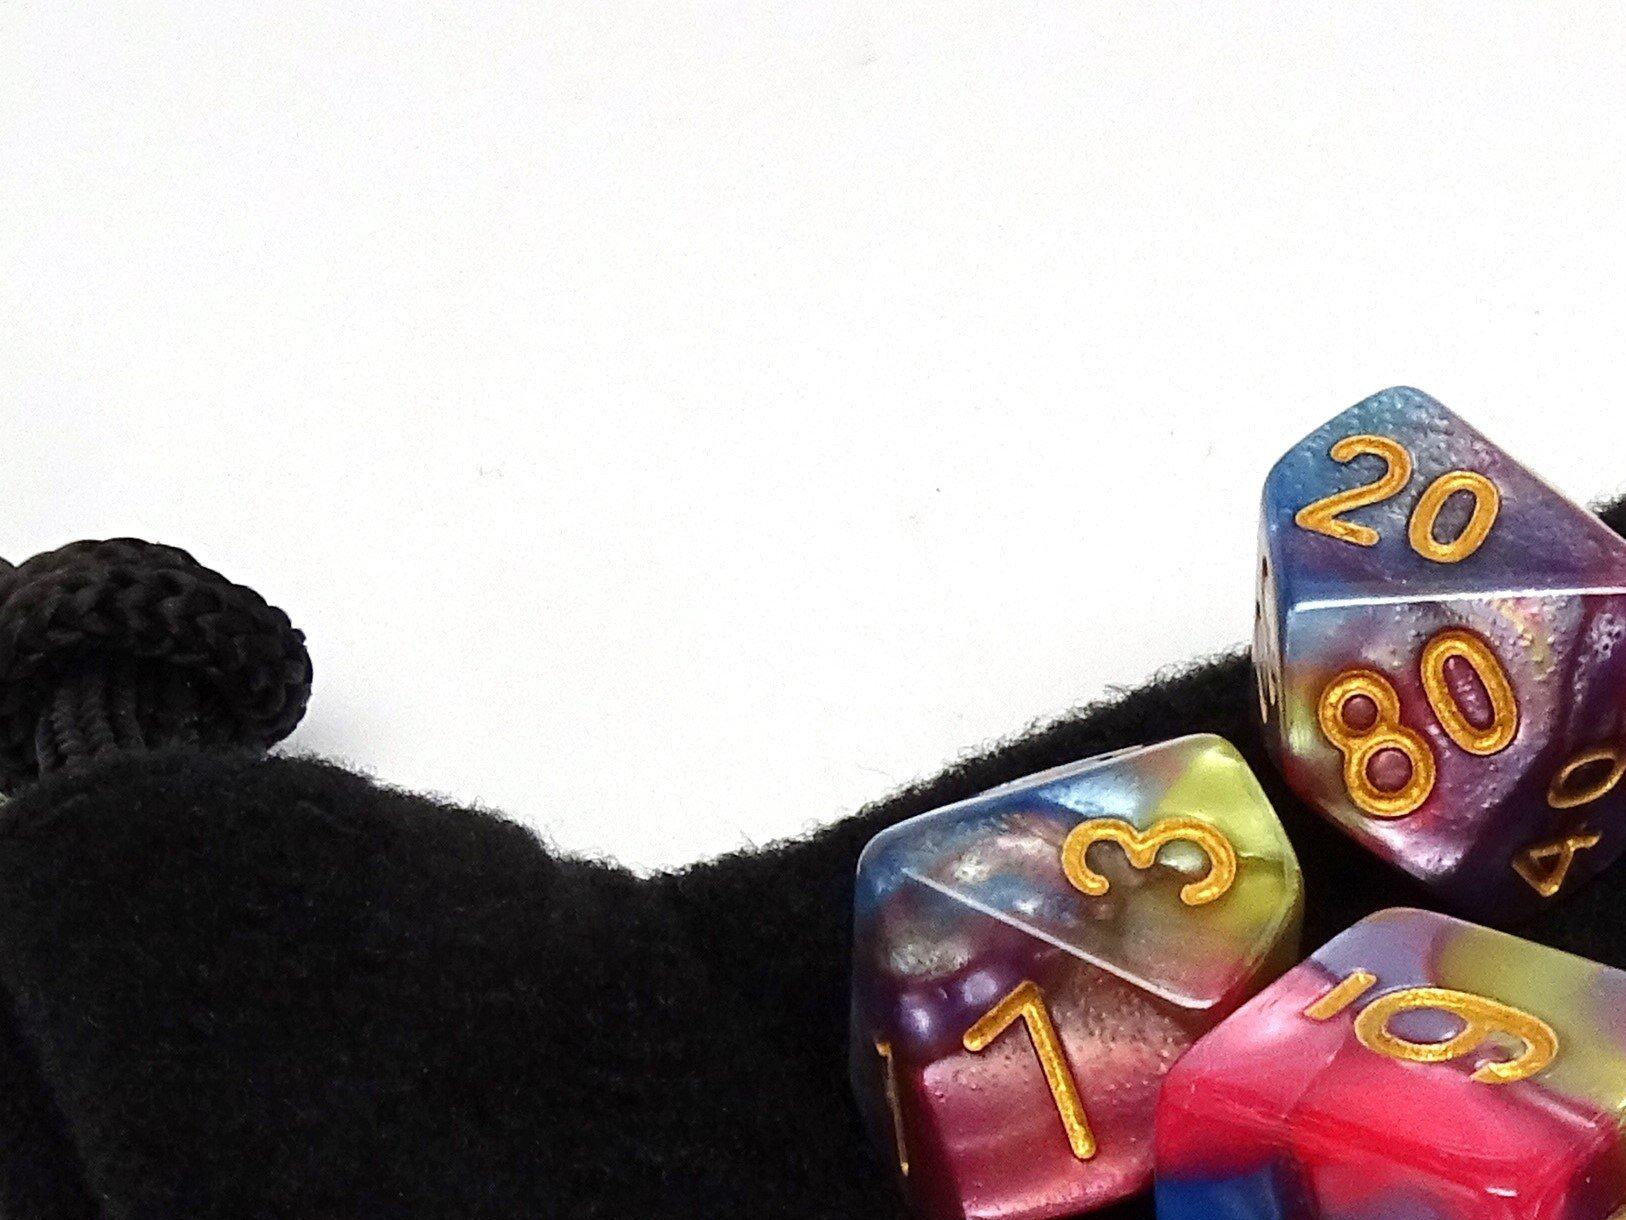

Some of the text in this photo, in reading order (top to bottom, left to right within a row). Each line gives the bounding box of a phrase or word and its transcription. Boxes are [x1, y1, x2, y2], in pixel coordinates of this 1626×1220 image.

[1295, 434, 1501, 563] 20
[1317, 628, 1520, 818] 80
[1061, 817, 1237, 906] 3
